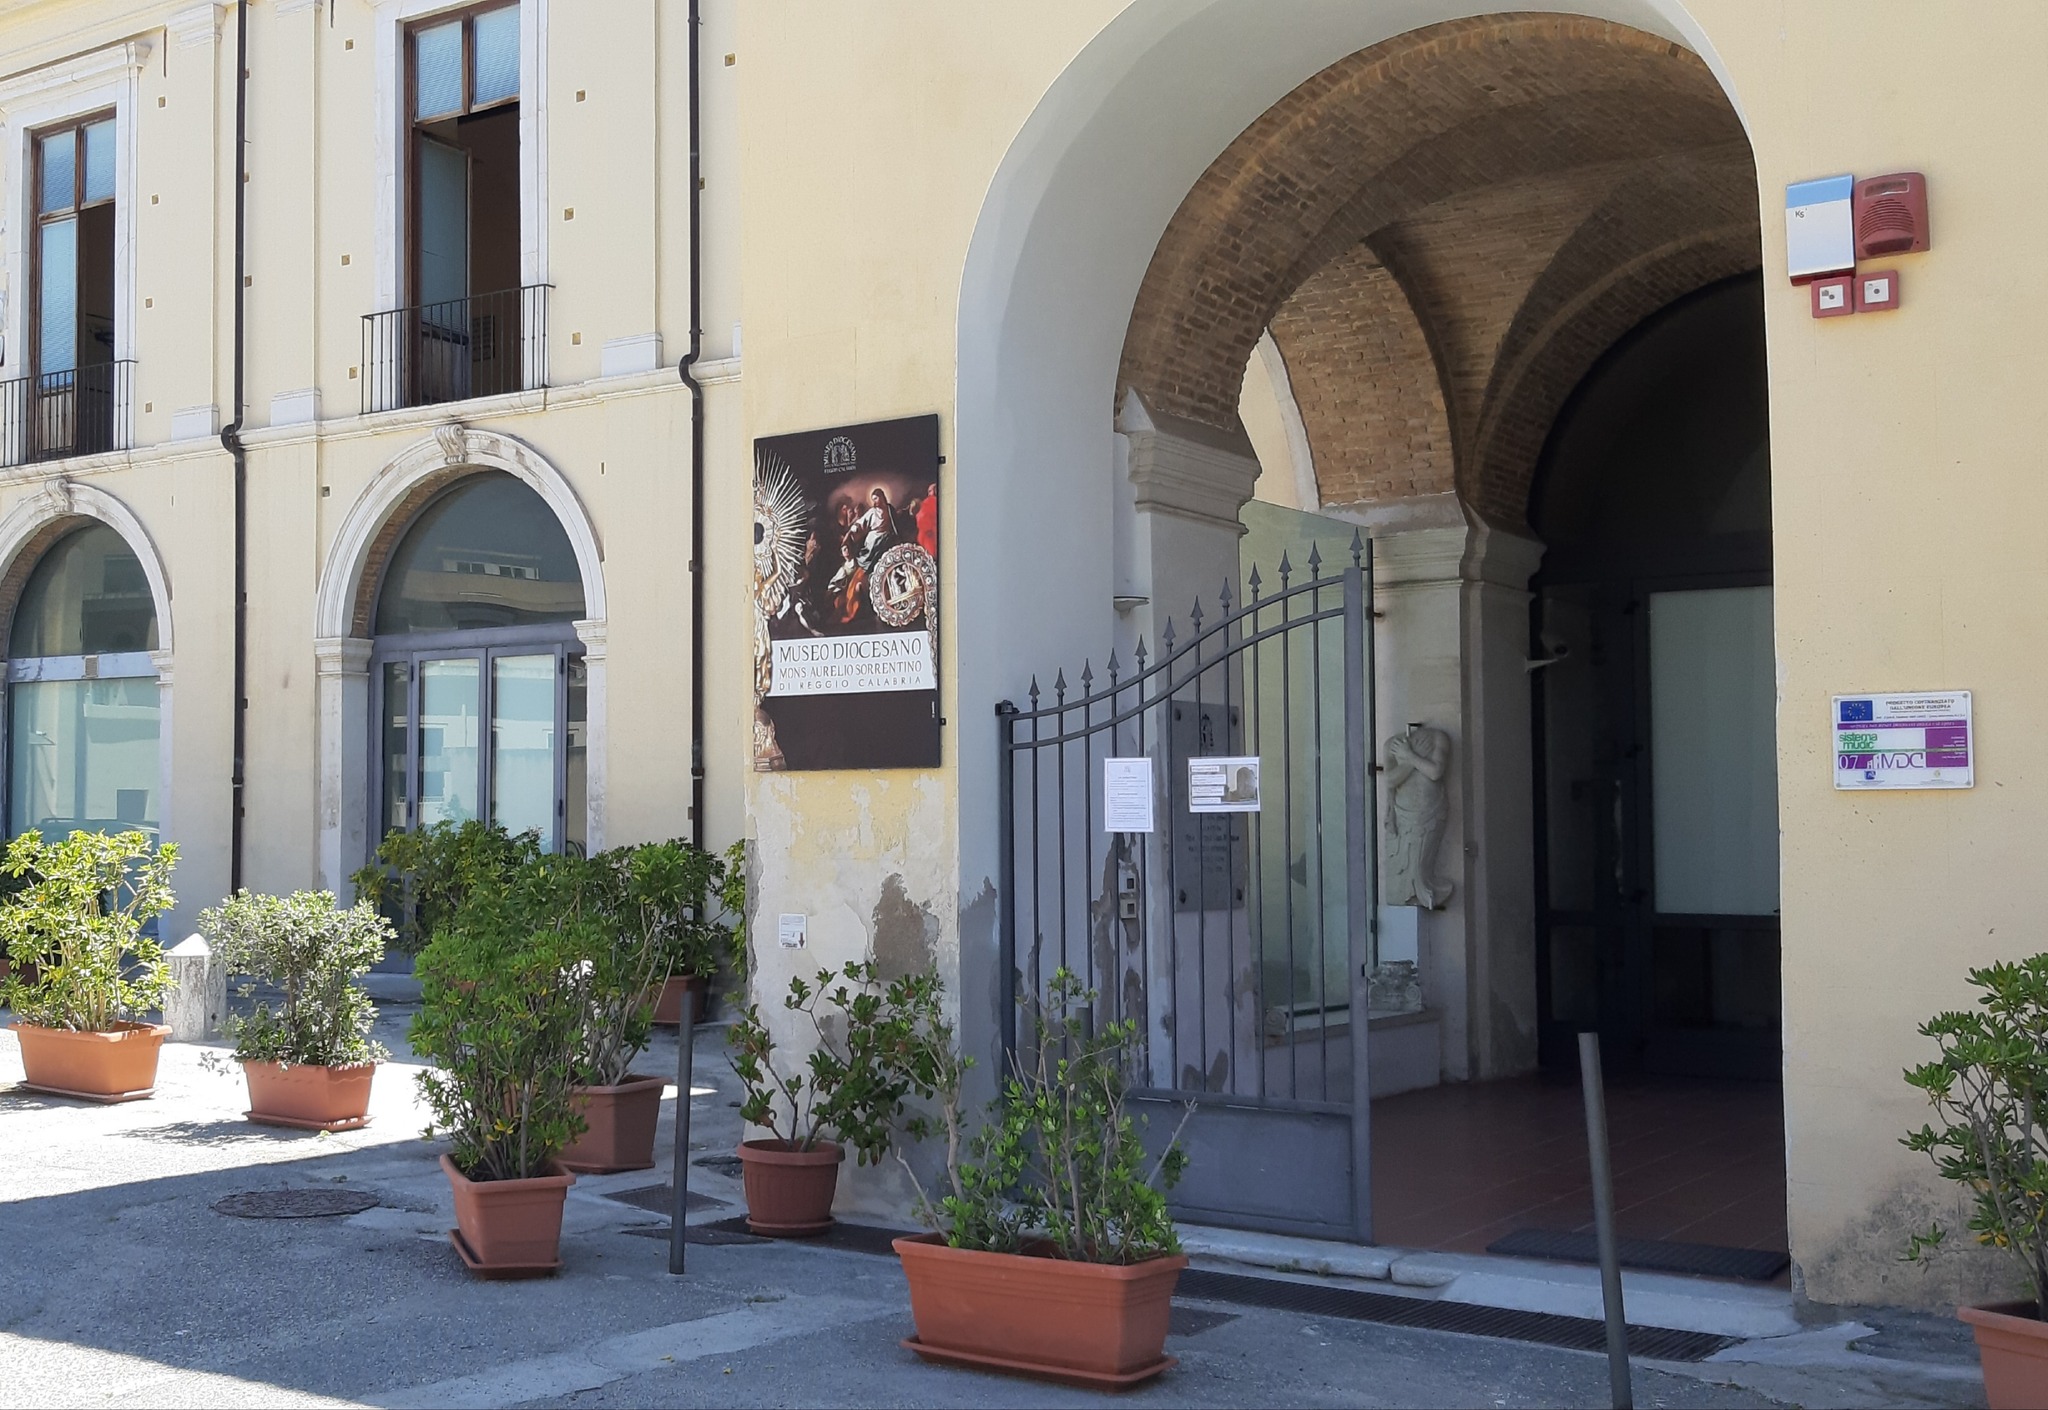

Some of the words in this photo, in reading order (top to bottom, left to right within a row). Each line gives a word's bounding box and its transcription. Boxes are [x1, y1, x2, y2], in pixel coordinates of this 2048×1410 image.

[823, 440, 834, 465] MUSEO
[833, 436, 857, 461] DIOCESANO
[780, 644, 829, 663] MUSEO
[833, 638, 922, 659] DIOCESANO
[810, 664, 853, 678] AURELIO
[856, 660, 922, 676] SORRENTINO
[779, 683, 791, 691] DI
[800, 680, 849, 689] REGGIO
[858, 676, 921, 687] CALABRIA
[1839, 732, 1878, 742] sistema
[1843, 740, 1874, 749] mudic
[1839, 755, 1858, 769] 07
